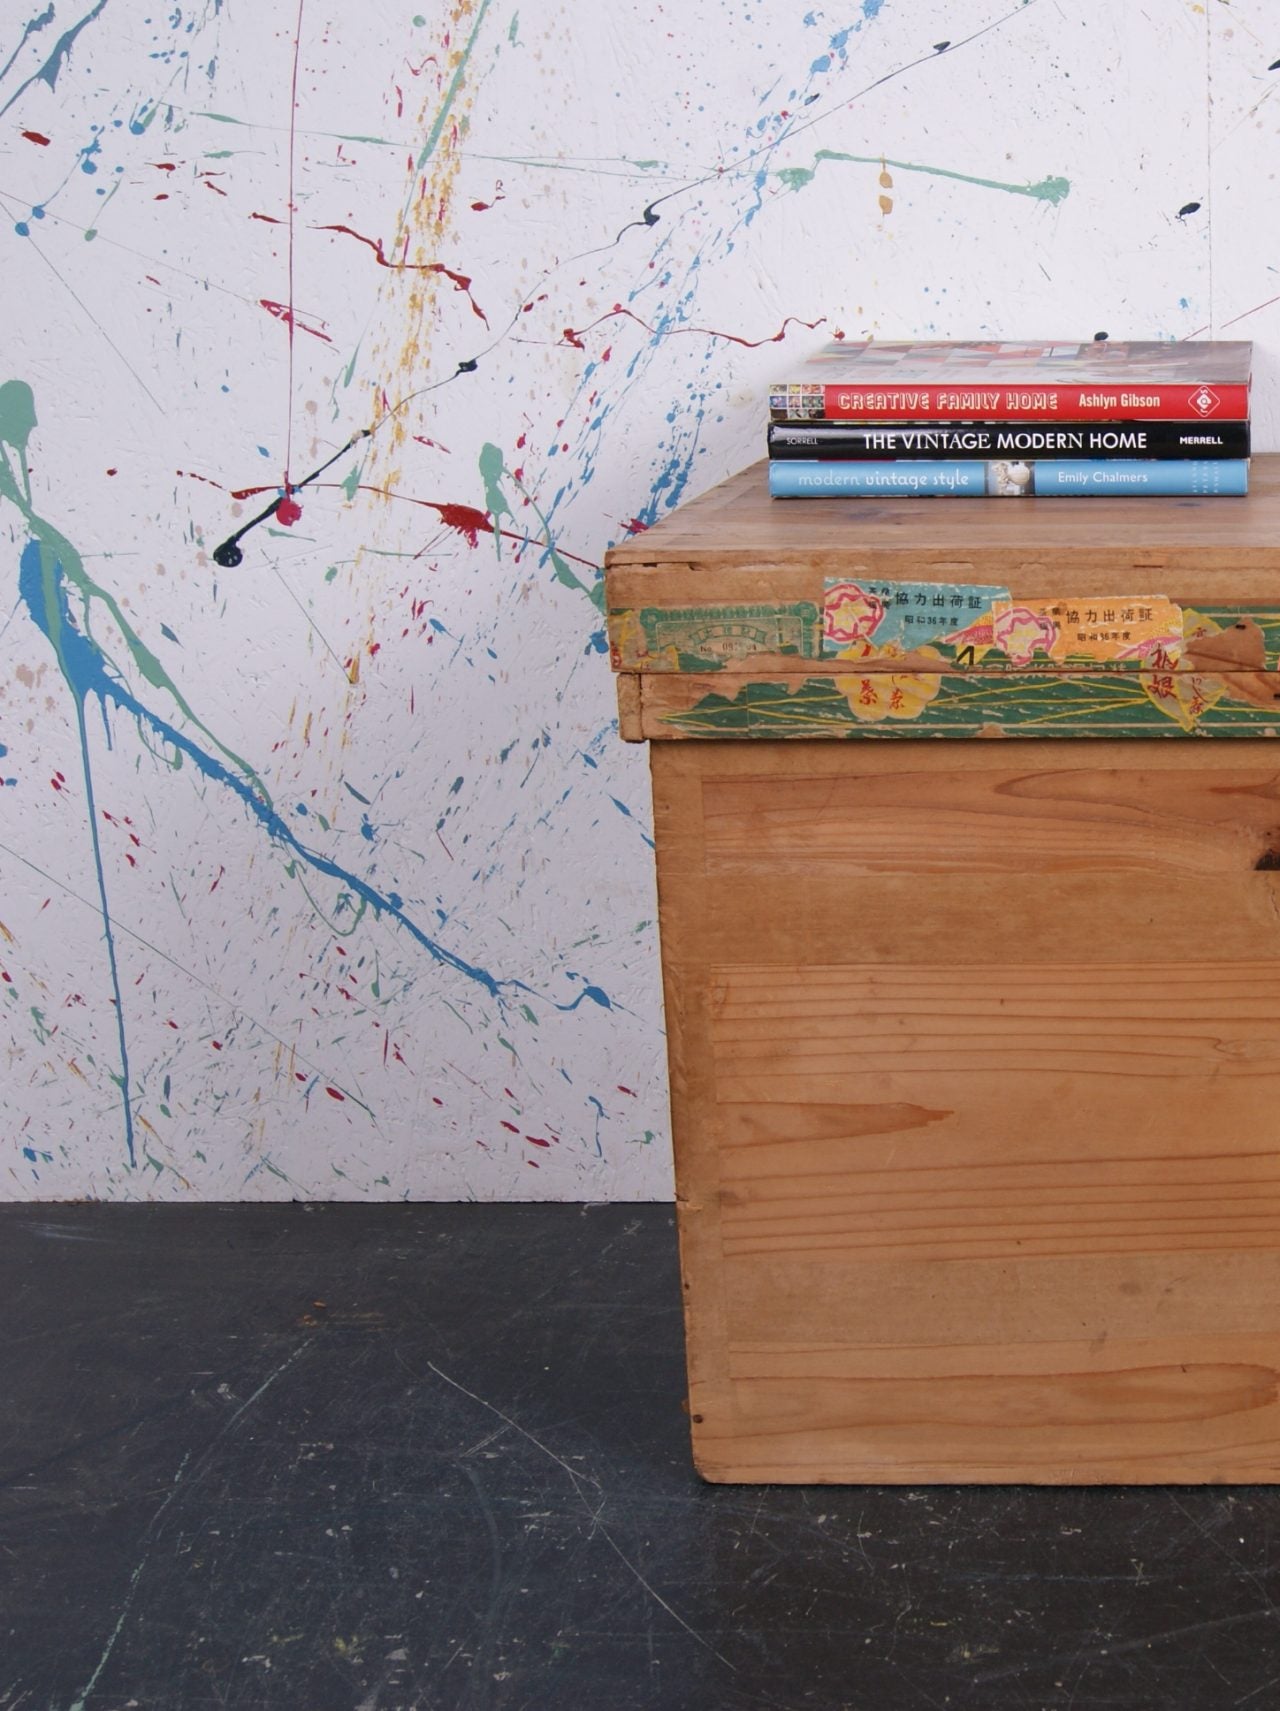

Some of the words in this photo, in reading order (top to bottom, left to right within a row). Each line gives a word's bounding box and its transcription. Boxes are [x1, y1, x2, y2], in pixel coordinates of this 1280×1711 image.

[838, 392, 930, 411] CREATIVE
[936, 392, 1000, 410] FAMILY
[1006, 392, 1058, 410] HOME
[1078, 393, 1117, 410] Ashlyn
[1120, 392, 1161, 408] Gibson
[863, 433, 896, 450] THE
[902, 433, 992, 450] VINTAGE
[996, 432, 1084, 450] MODERN
[1089, 432, 1148, 449] HOME
[1179, 435, 1224, 445] MERRELL
[799, 469, 861, 486] modern
[865, 470, 928, 490] vintage
[932, 469, 969, 490] style
[1057, 471, 1088, 485] Emily
[1092, 470, 1149, 484] Chalmers
